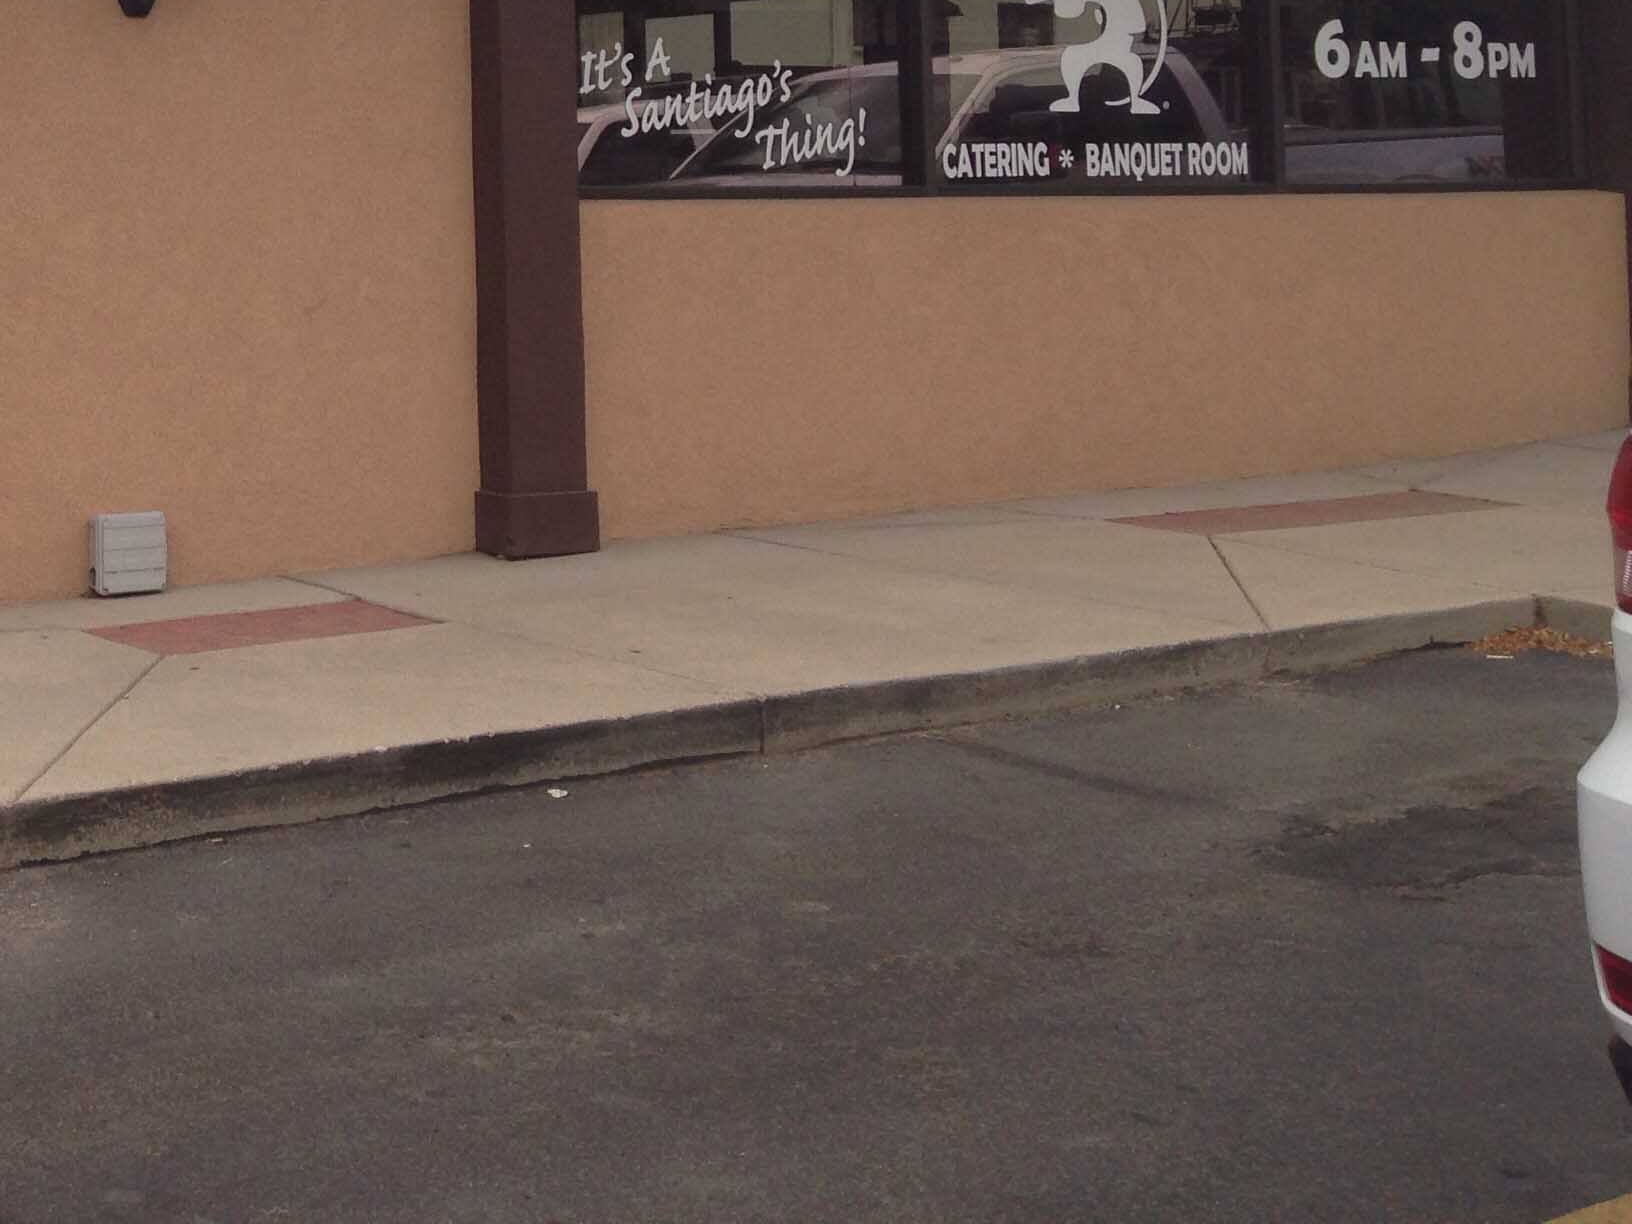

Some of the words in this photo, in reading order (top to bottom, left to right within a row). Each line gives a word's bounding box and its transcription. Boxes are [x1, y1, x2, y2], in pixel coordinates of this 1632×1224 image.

[579, 42, 635, 95] It's
[644, 37, 671, 82] A
[621, 59, 793, 138] Santiago's
[755, 108, 867, 177] Thing!
[942, 142, 1051, 178] CATERING
[1085, 142, 1184, 182] BANQUET
[1187, 142, 1249, 177] ROOM
